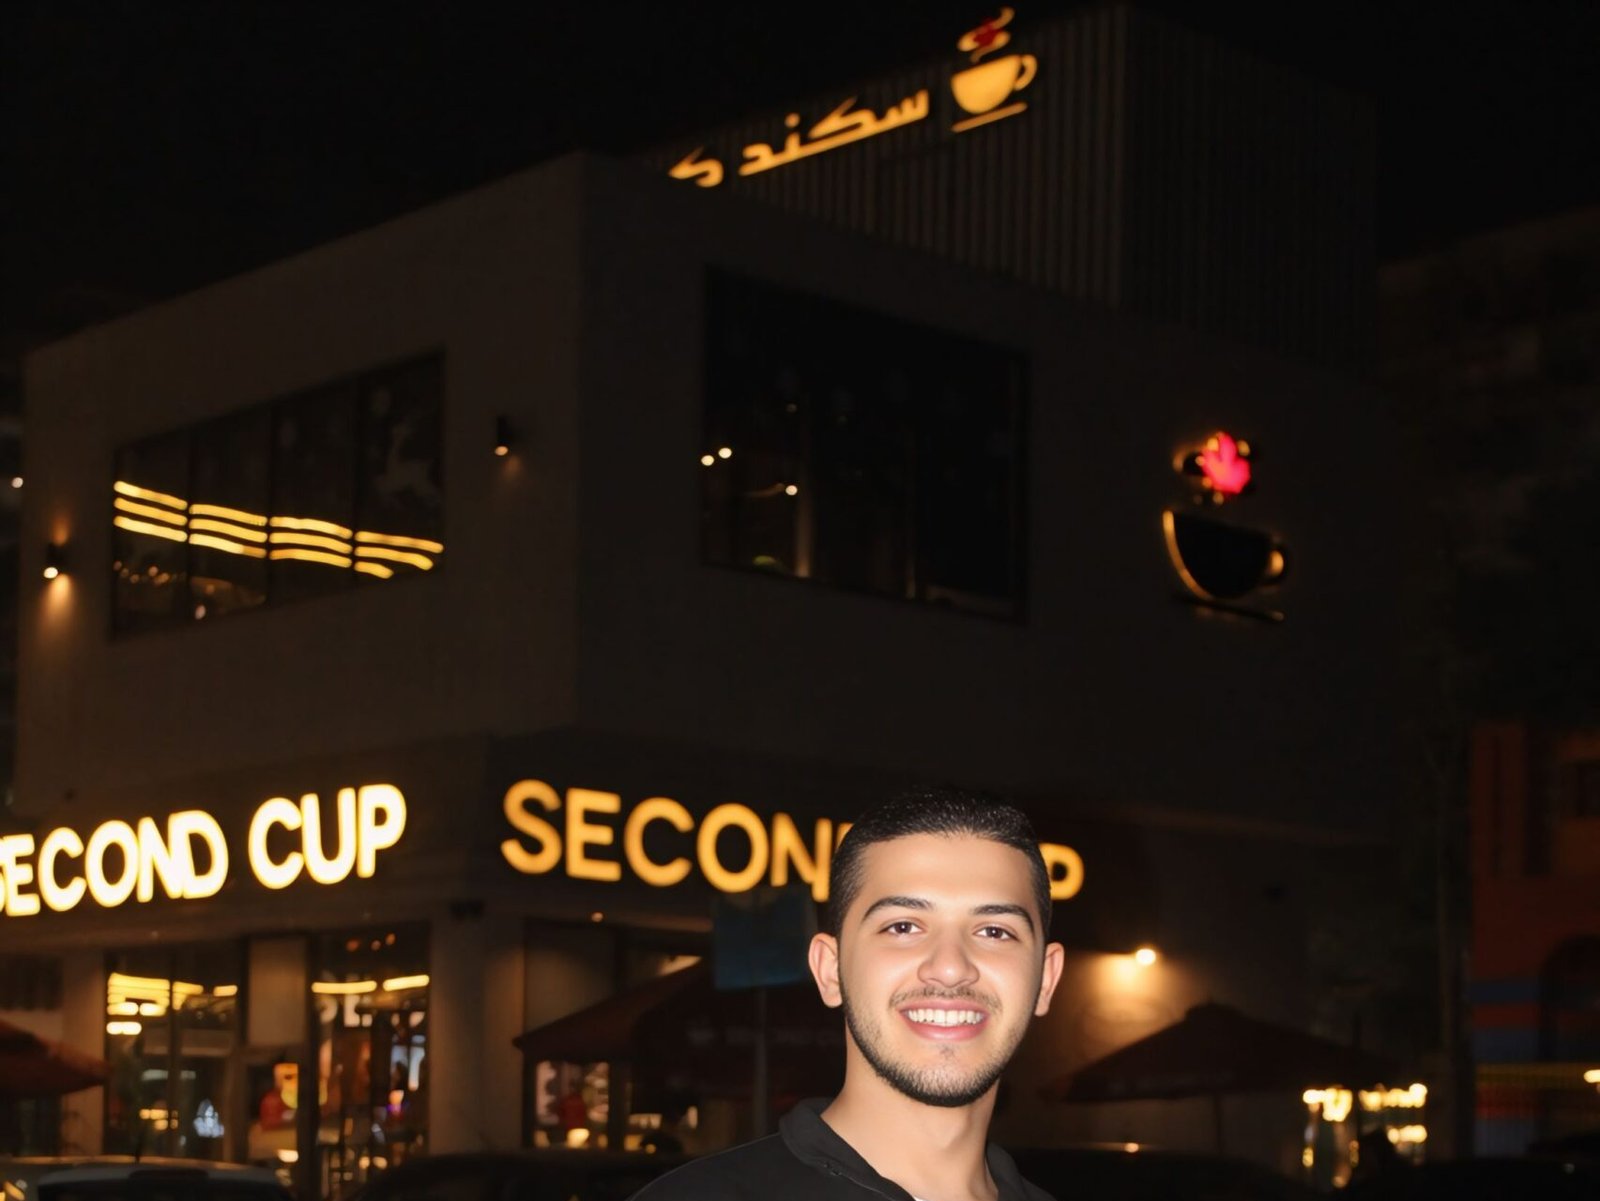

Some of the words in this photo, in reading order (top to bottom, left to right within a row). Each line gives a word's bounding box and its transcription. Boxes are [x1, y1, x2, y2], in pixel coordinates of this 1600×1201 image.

[738, 89, 929, 177] سكند
[0, 810, 229, 917] ECOND
[248, 784, 407, 890] CUP
[501, 779, 855, 903] SECON
